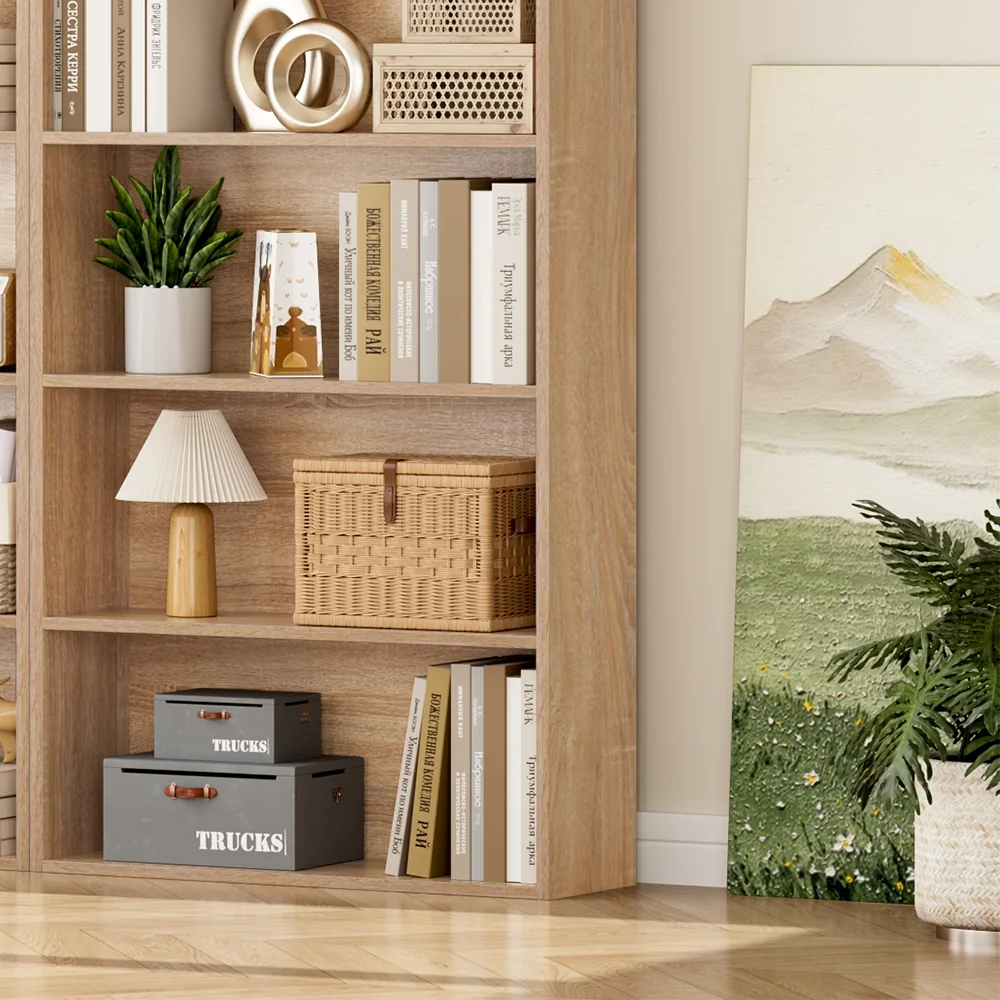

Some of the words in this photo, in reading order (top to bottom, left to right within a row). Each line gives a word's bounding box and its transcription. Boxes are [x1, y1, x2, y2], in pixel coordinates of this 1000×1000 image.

[66, 0, 79, 49] СЕСТРА
[151, 3, 162, 37] ФРИДРИХ
[151, 39, 162, 70] ЭНГЕЛЬС
[66, 52, 79, 93] КЕРРИ
[497, 196, 511, 236] РЕМАРК
[366, 207, 382, 277] БОЖЕСТВЕННАЯ
[344, 247, 356, 285] Уличный
[345, 287, 353, 302] кот
[366, 279, 382, 322] КОМЕДИЯ
[500, 263, 517, 341] Триумфальная
[344, 304, 352, 315] по
[344, 315, 352, 342] имени
[365, 328, 387, 355] РАЙ
[344, 344, 356, 361] Боб
[500, 344, 514, 368] арка
[424, 693, 442, 766] БОЖЕСТВЕННАЯ
[212, 738, 267, 753] TRUCKS
[404, 736, 418, 776] Уличный
[401, 778, 409, 793] кот
[419, 767, 434, 813] КОМЕДИЯ
[526, 755, 537, 837] Триумфальная
[398, 795, 407, 806] по
[395, 807, 405, 836] имени
[415, 820, 430, 849] РАЙ
[196, 830, 284, 854] TRUCKS
[391, 837, 402, 855] Боб
[526, 841, 537, 866] арка
